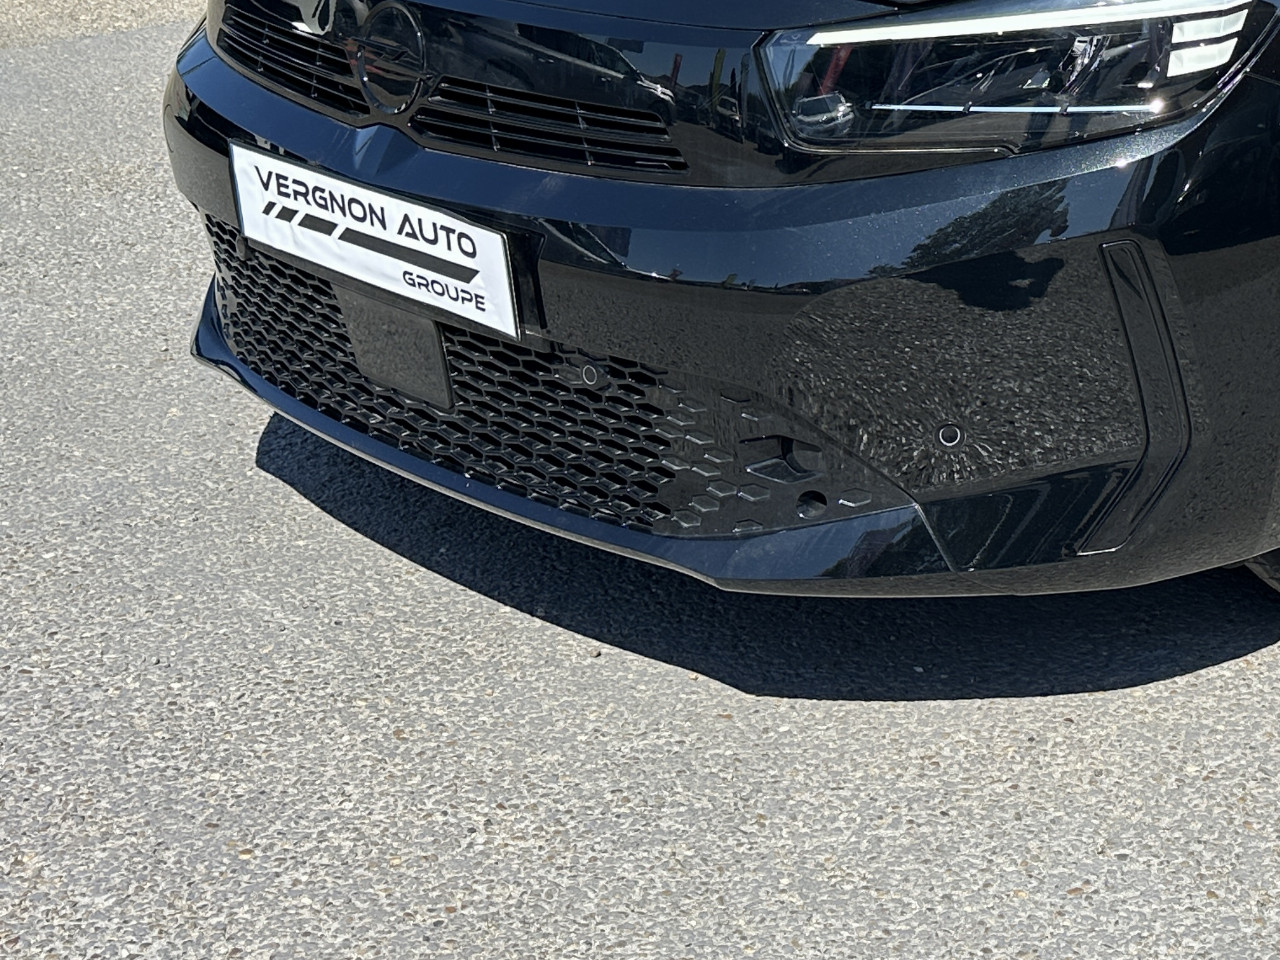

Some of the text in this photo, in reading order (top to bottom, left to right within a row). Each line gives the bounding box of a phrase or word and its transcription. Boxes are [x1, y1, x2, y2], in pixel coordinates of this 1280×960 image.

[254, 165, 478, 259] VERGNON AUTO
[402, 270, 486, 312] GROUPE
